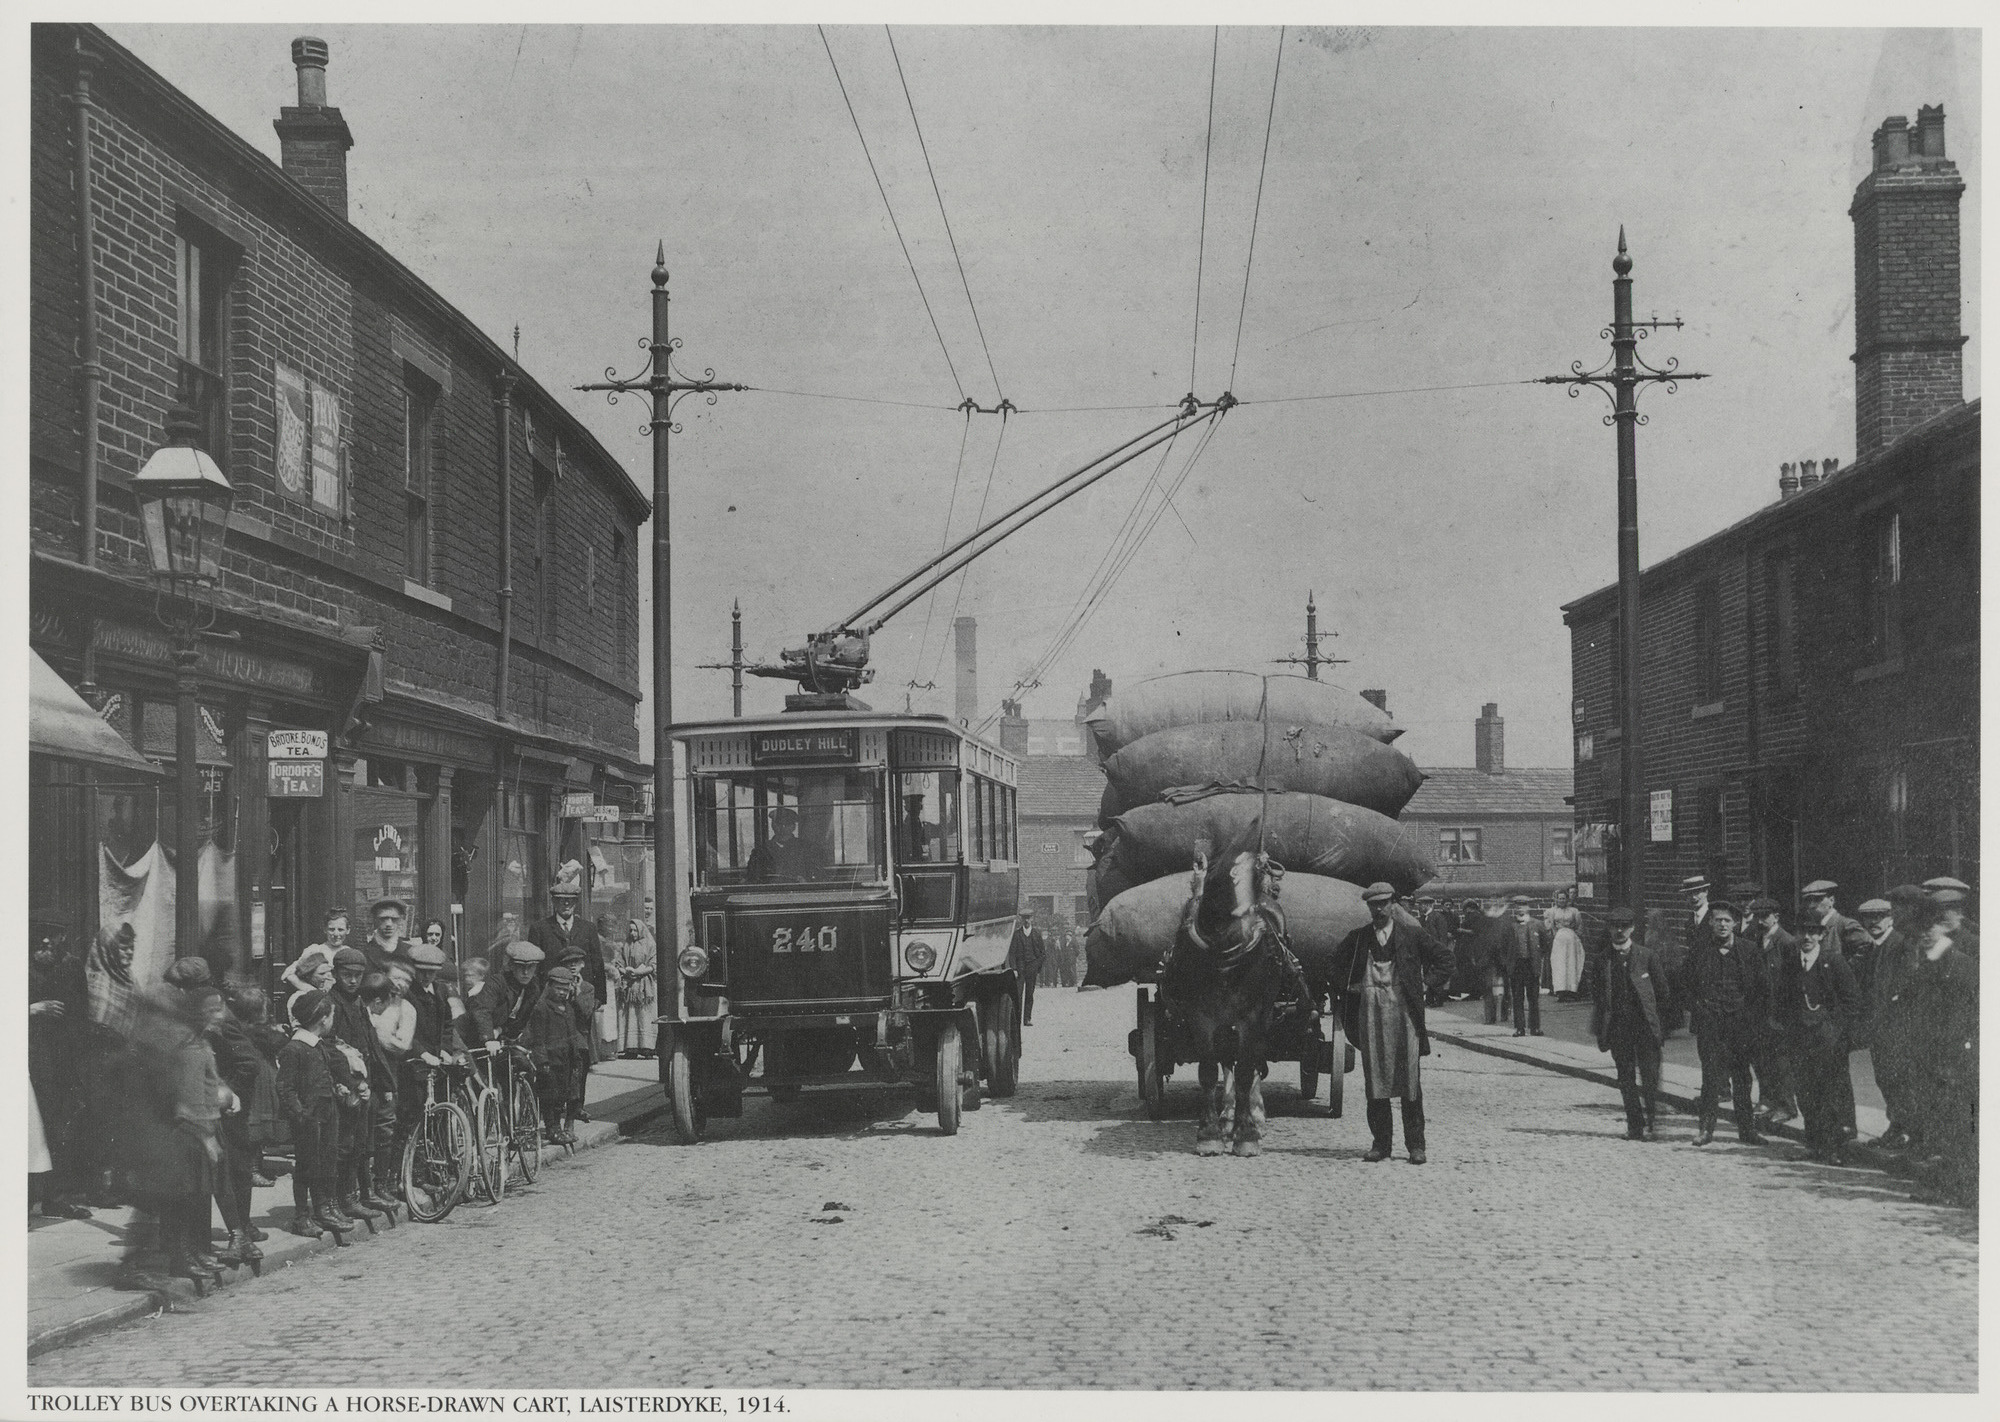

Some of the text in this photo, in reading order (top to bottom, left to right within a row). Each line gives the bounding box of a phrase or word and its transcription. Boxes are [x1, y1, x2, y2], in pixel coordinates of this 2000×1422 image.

[762, 737, 847, 751] DUDLEY HILL
[281, 777, 309, 794] TEA
[772, 925, 838, 953] 240
